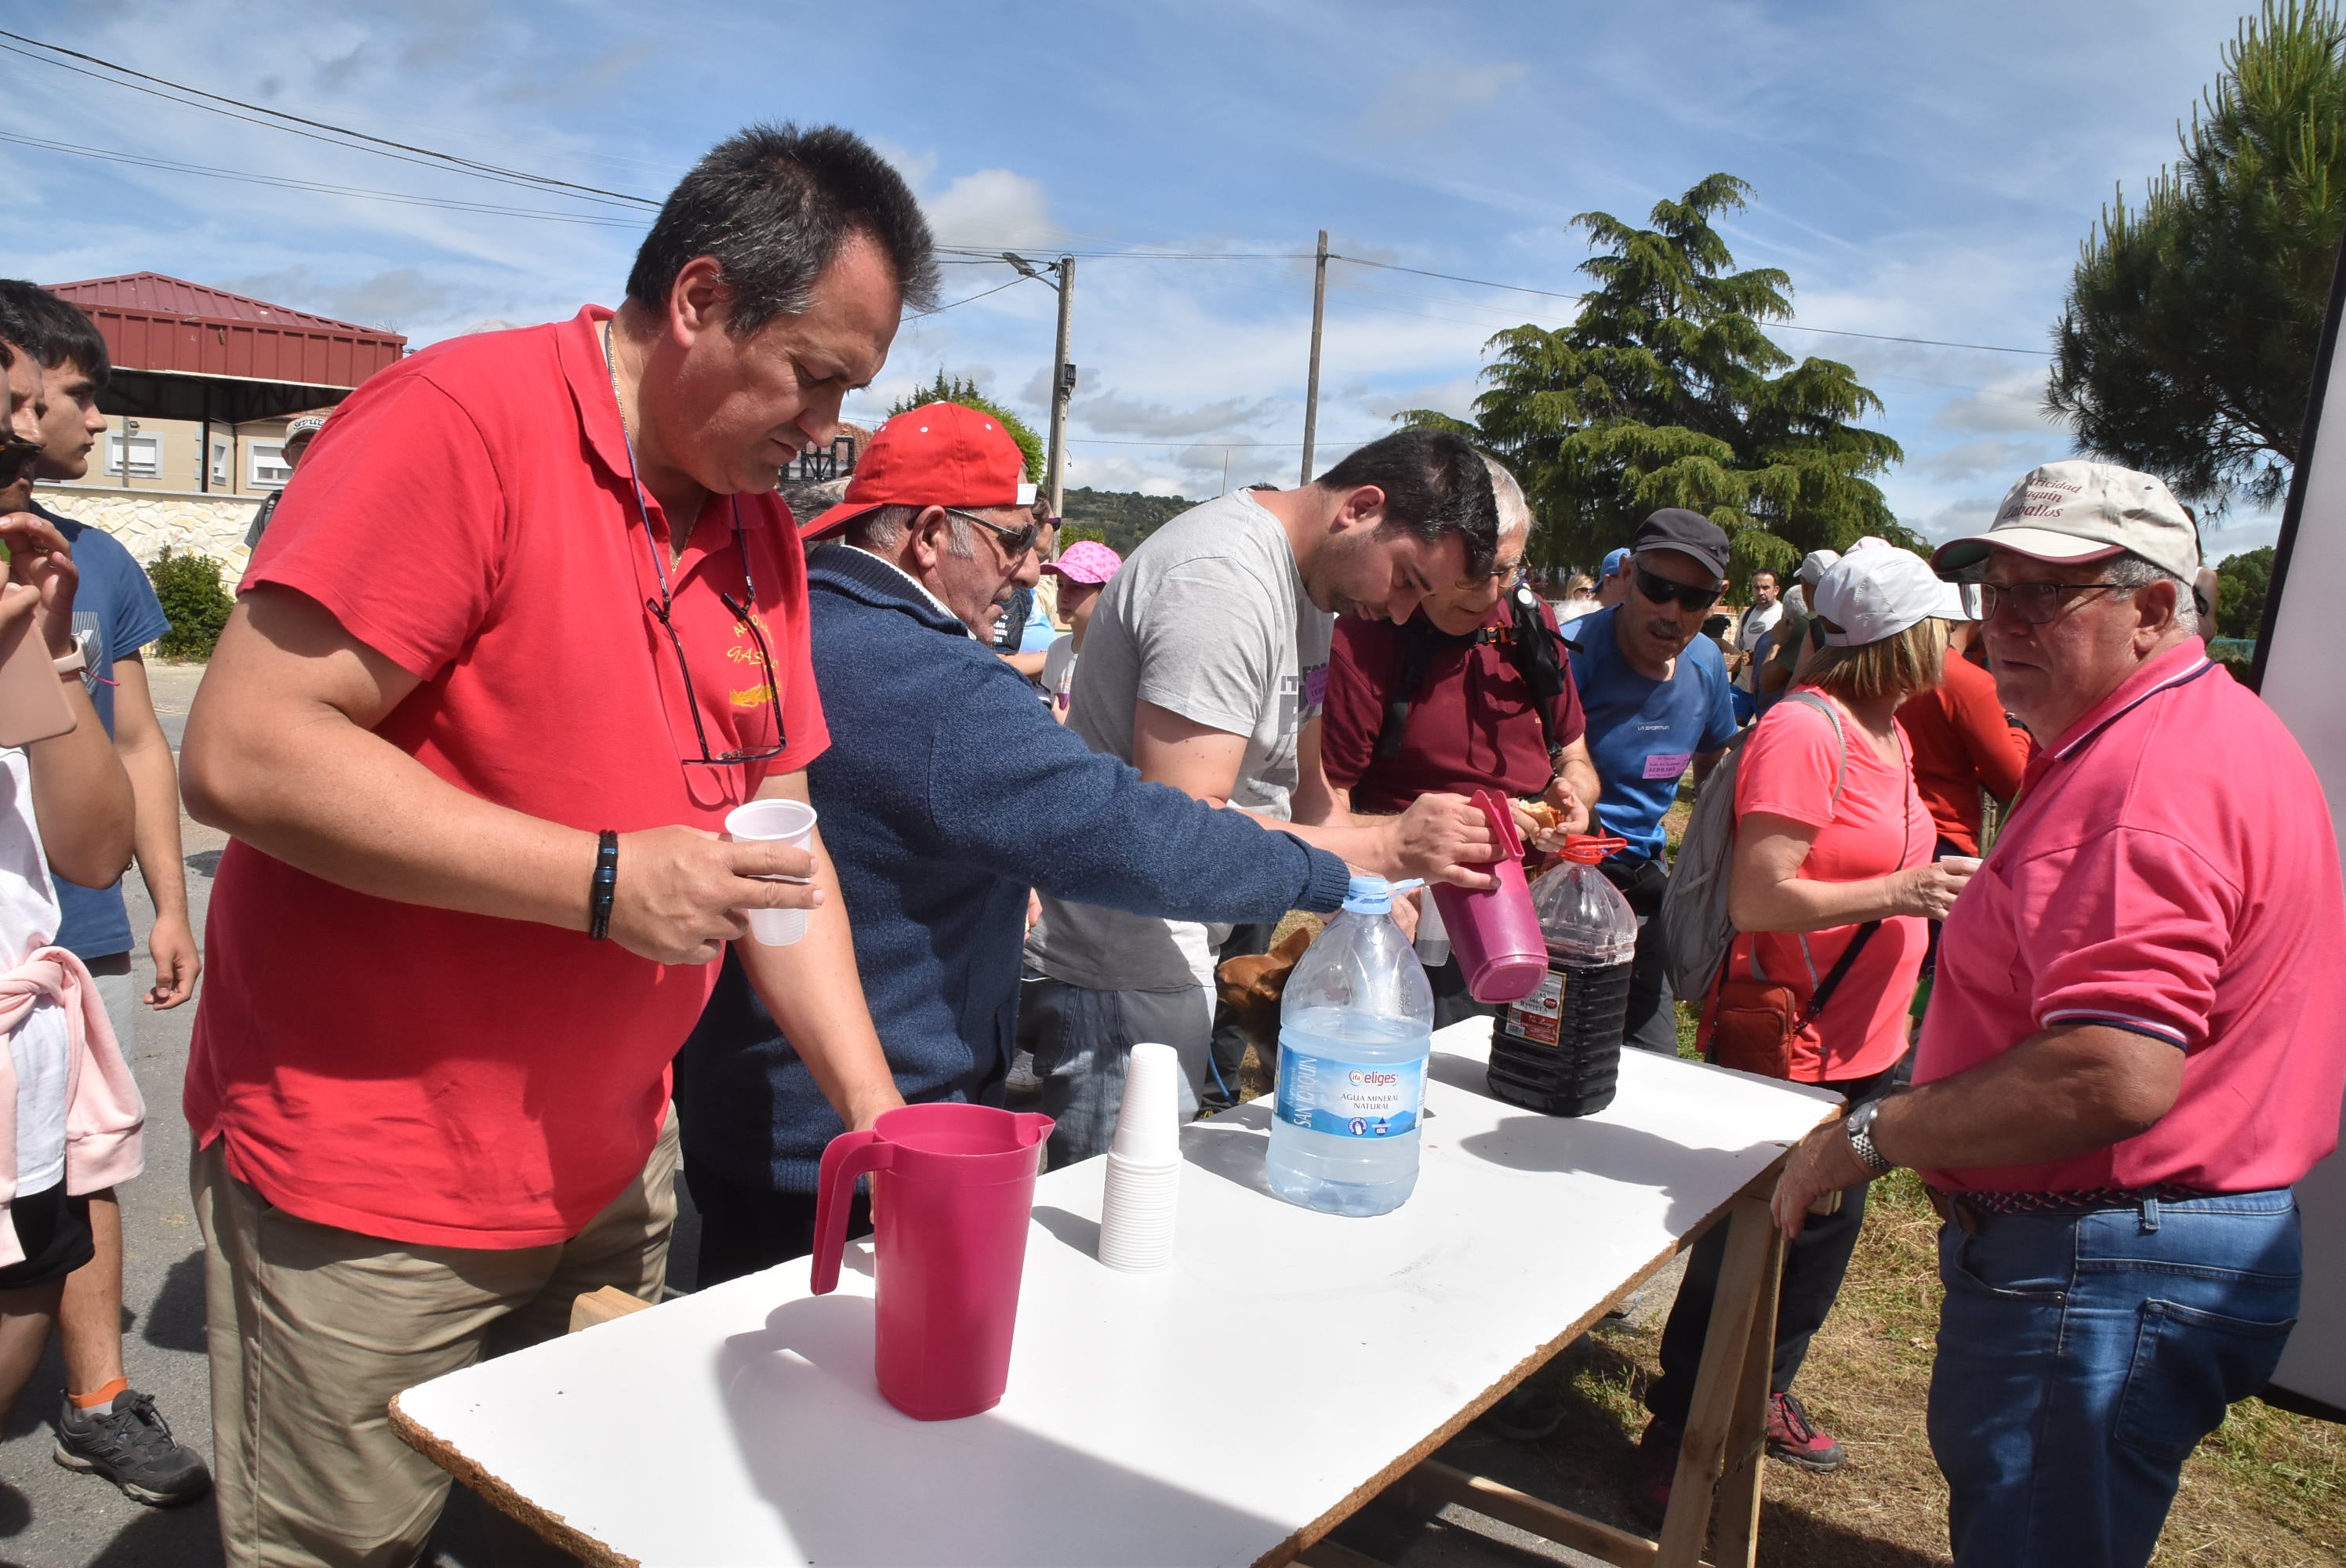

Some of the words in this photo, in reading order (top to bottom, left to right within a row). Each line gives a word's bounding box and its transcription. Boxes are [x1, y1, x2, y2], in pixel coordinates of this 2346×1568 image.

[294, 418, 324, 430] Sevill
[2025, 490, 2062, 503] aquín
[1352, 1073, 1361, 1081] ifa
[1364, 1071, 1396, 1087] eliges
[1342, 1093, 1365, 1102] AGUA
[1293, 1104, 1312, 1128] SAN
